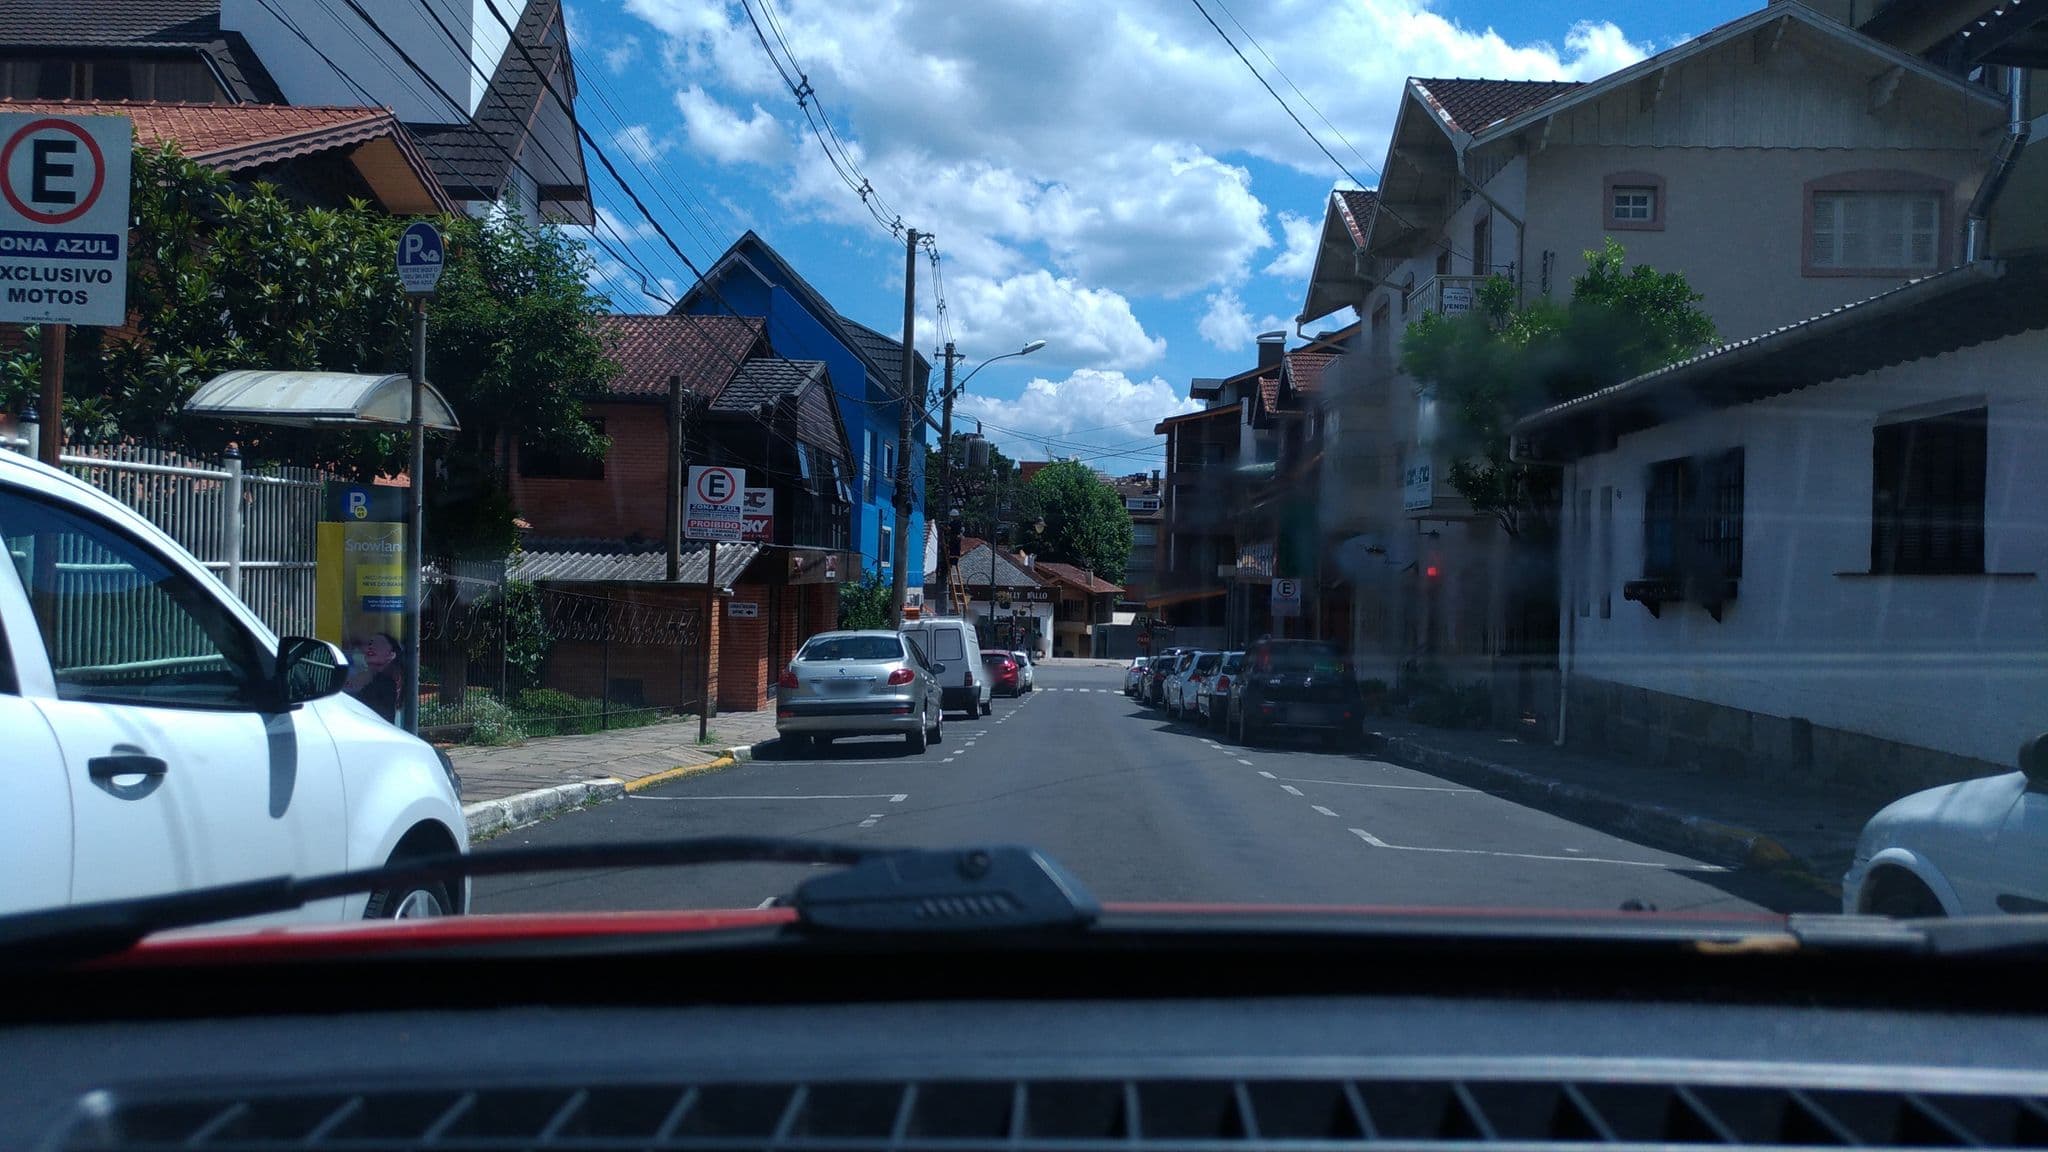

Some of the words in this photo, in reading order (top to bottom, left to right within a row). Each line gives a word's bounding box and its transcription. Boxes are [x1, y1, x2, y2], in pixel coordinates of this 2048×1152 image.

[31, 139, 76, 204] E
[0, 236, 48, 253] ONA
[55, 238, 113, 254] AZUL
[405, 233, 423, 264] P
[0, 265, 113, 284] XCLUSIVO
[8, 287, 88, 305] MOTOS
[709, 475, 725, 497] E
[349, 492, 366, 513] P
[690, 520, 738, 529] PROIBIDO
[742, 519, 768, 533] SKY
[1282, 582, 1291, 594] E
